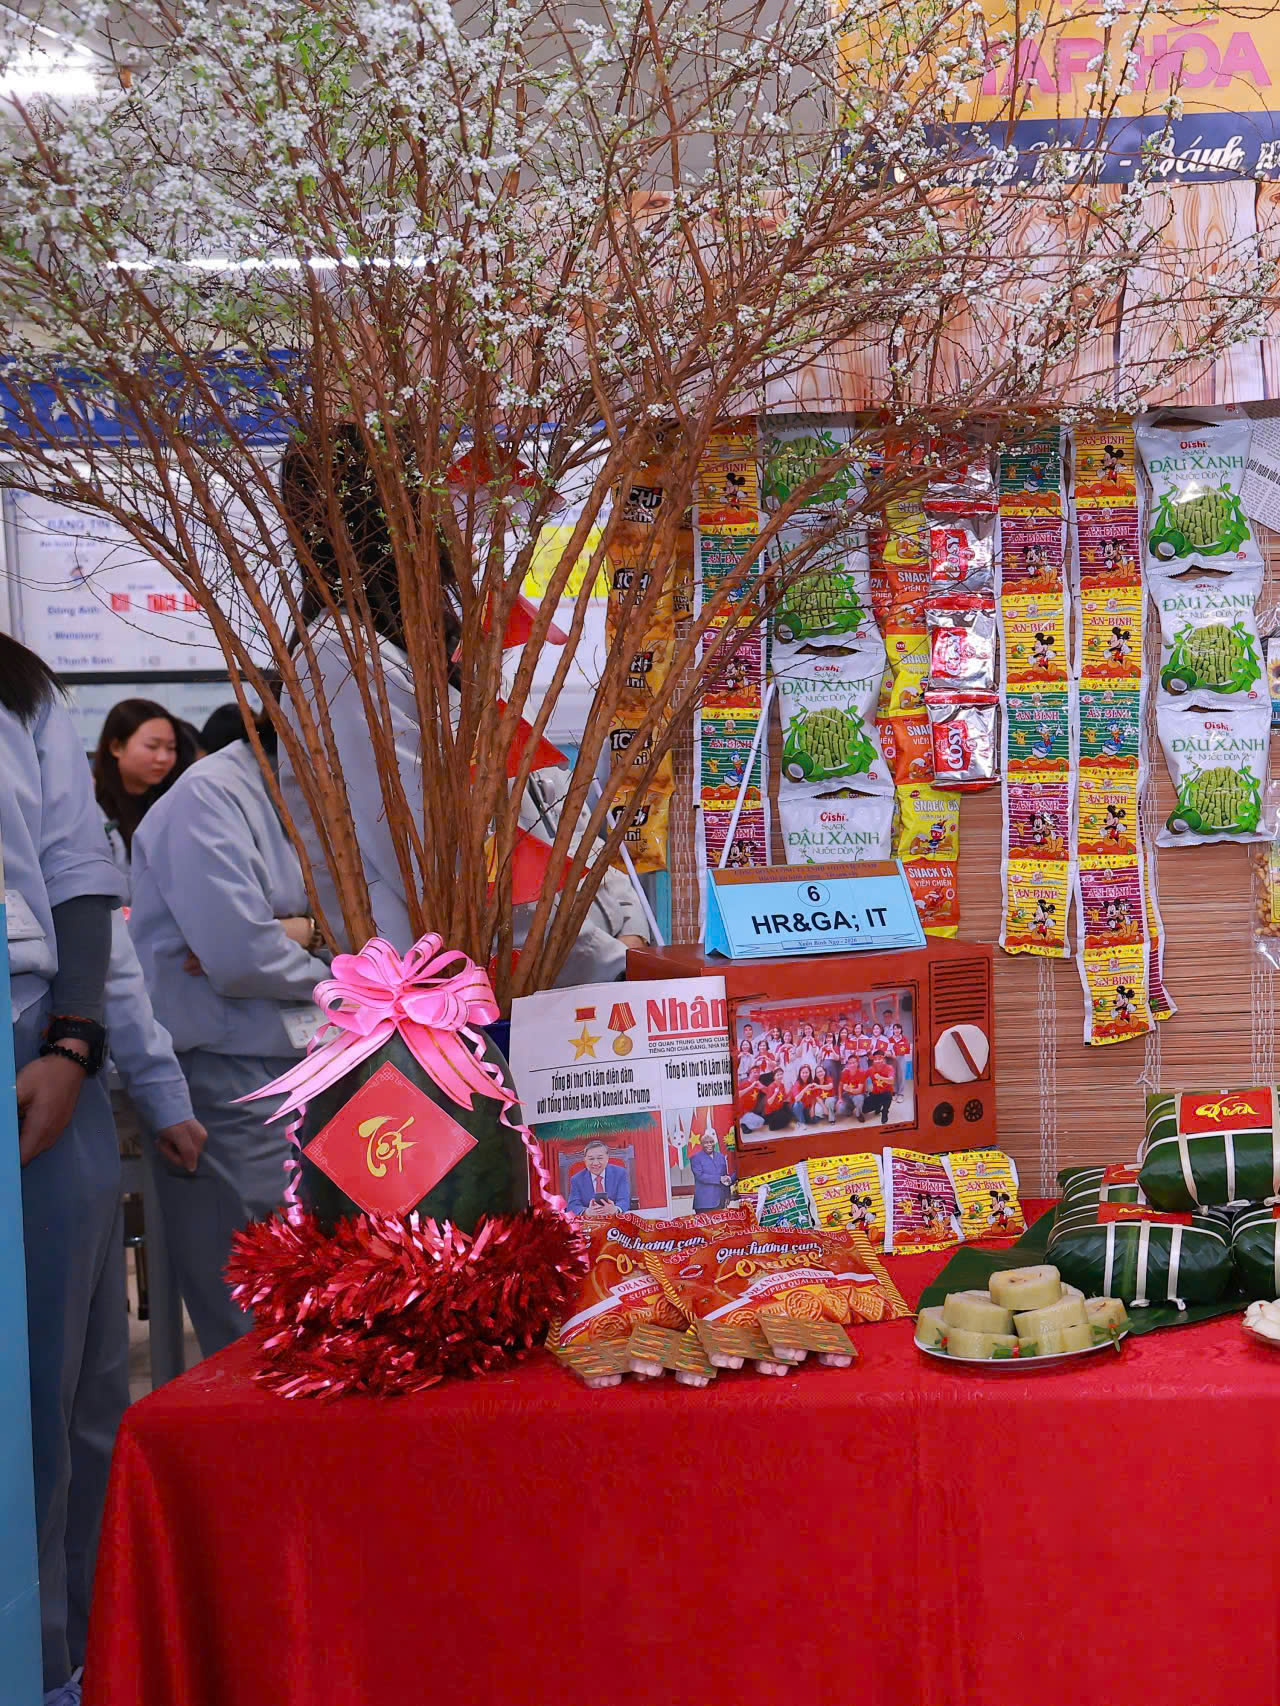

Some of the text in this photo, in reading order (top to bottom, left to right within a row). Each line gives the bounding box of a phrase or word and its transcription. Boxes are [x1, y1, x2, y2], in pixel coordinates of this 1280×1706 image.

[1192, 455, 1244, 471] XANH
[1206, 593, 1258, 609] XANH
[1213, 737, 1266, 752] XANH
[828, 831, 880, 845] XANH
[908, 866, 943, 879] SNACK
[807, 885, 821, 902] 6
[751, 907, 888, 935] HR&GA; IT
[647, 996, 729, 1034] Nhân
[602, 1088, 623, 1107] Donald
